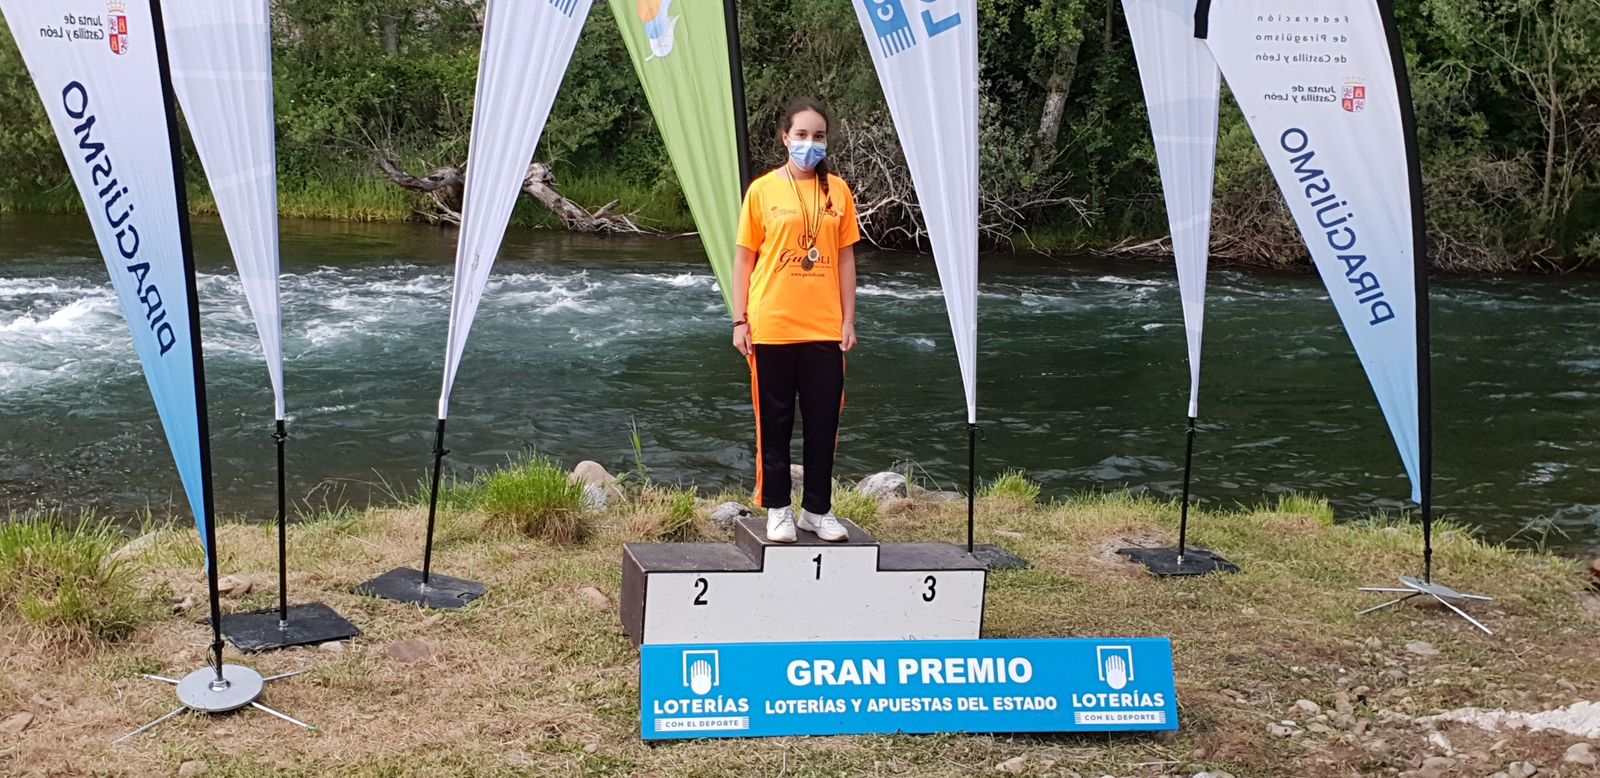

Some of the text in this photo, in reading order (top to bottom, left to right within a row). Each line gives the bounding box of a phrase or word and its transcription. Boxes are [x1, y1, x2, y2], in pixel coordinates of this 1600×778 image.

[813, 553, 823, 580] 1
[693, 578, 709, 606] 2
[922, 575, 937, 602] 3
[787, 657, 1033, 687] GRAN PREMIO
[654, 695, 750, 714] LOTERÍAS
[765, 696, 1057, 714] LOTERÍAS Y APUESTAS DEL ESTADO
[1072, 690, 1165, 708] LOTERÍAS
[699, 719, 739, 727] DEPORTE
